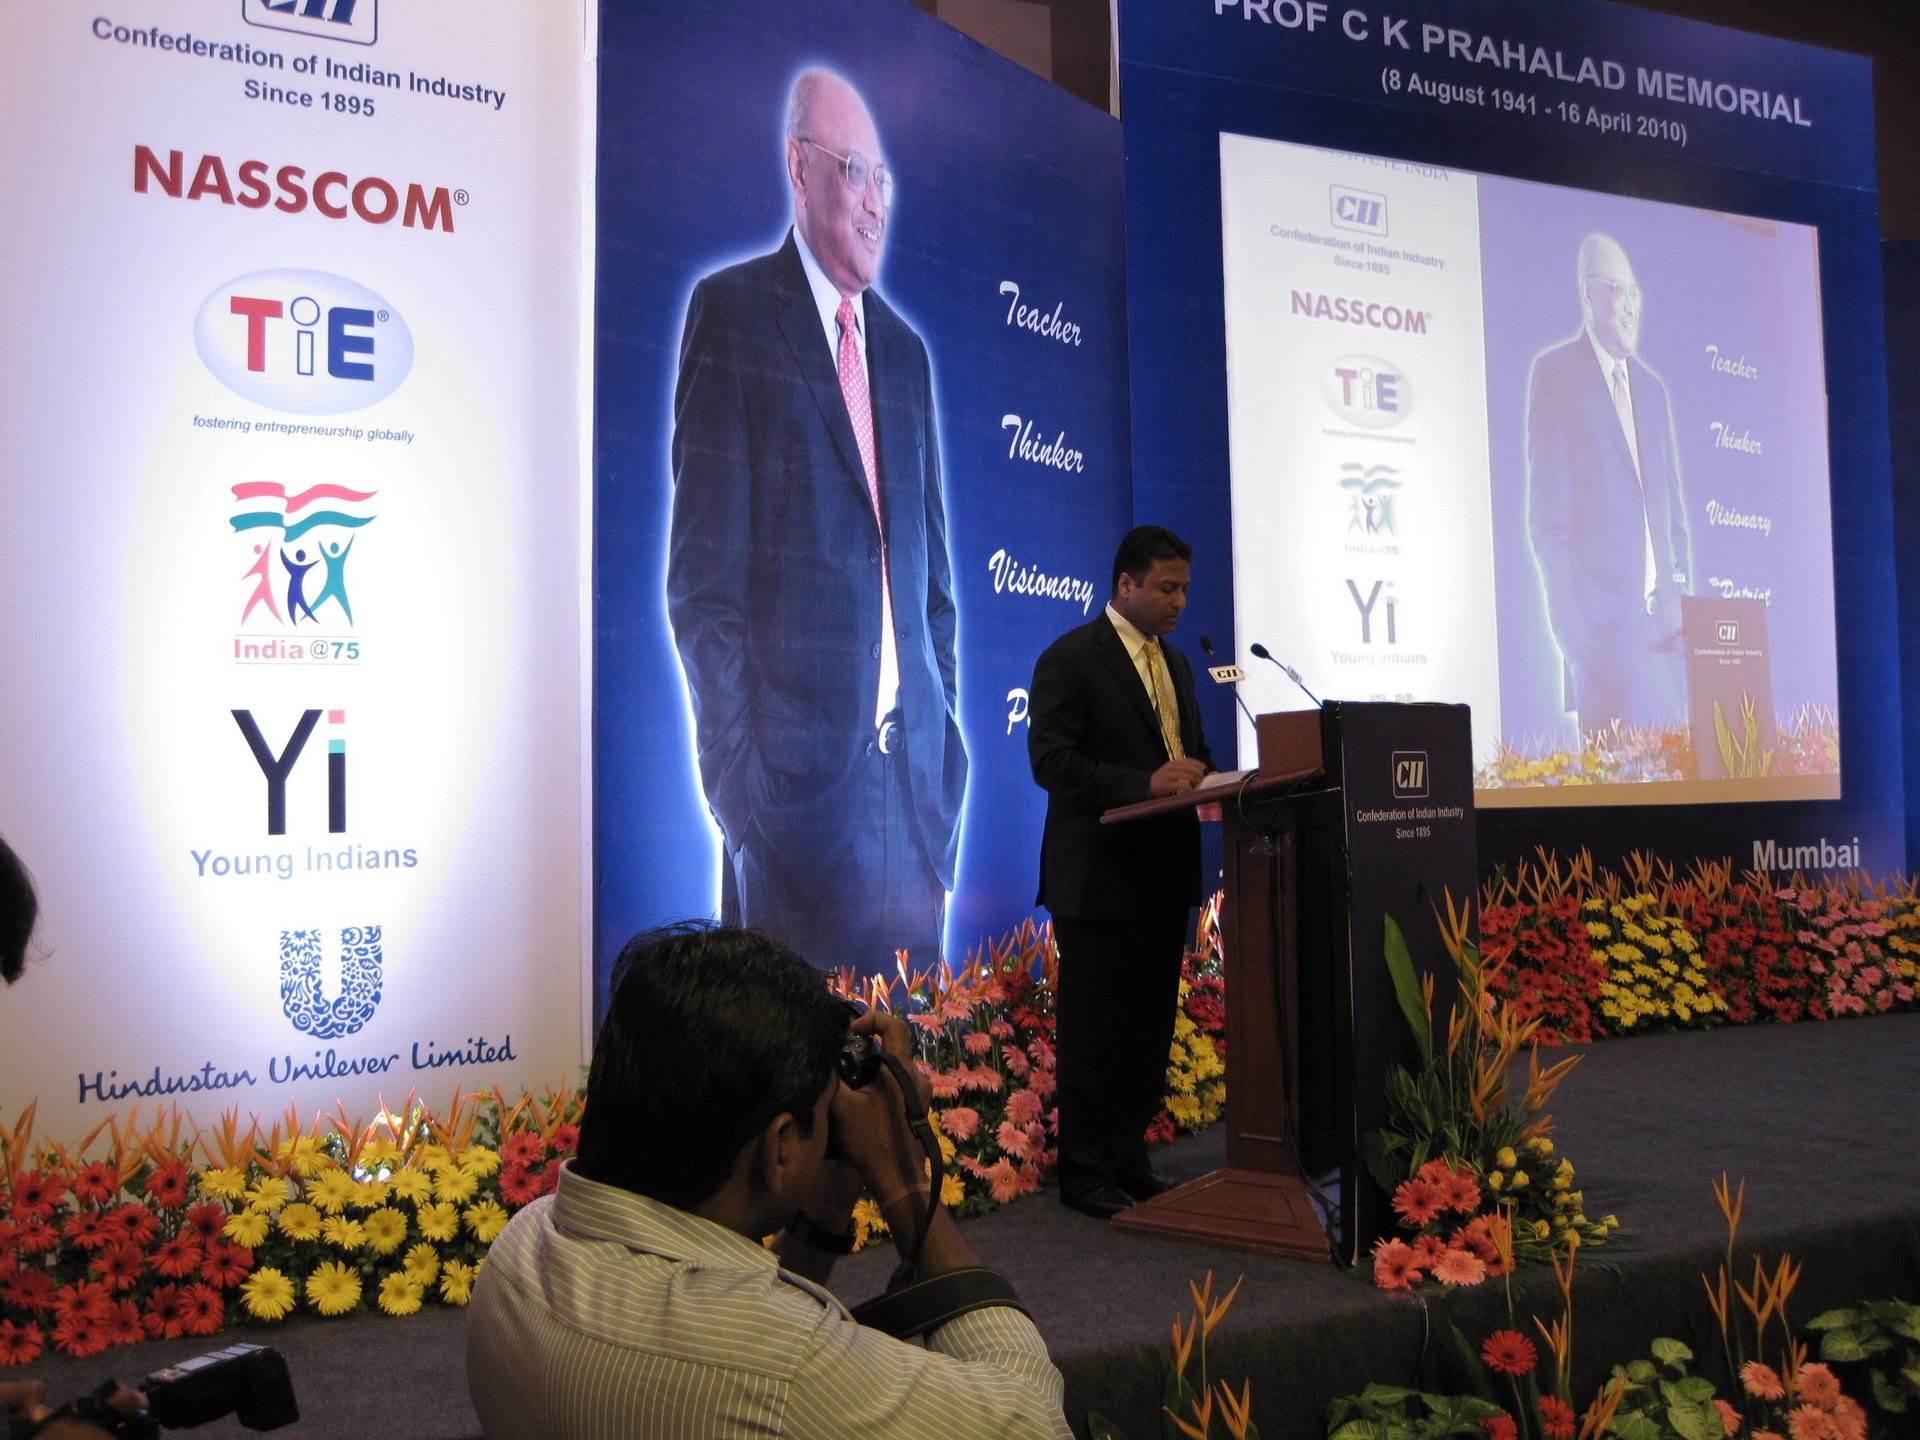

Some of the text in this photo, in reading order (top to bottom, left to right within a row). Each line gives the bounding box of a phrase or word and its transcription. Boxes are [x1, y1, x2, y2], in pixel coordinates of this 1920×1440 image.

[91, 17, 506, 110] Confederation of Indian Industry
[1342, 9, 1370, 41] C
[1382, 15, 1410, 50] K
[1422, 23, 1625, 90] PRAHALAD
[1636, 66, 1812, 127] MEMORIAL
[244, 78, 375, 117] Since 1895
[1381, 67, 1401, 94] (8
[1407, 72, 1485, 105] August
[1491, 88, 1537, 116] 1941
[1557, 101, 1580, 124] 16
[1585, 106, 1631, 133] April
[1637, 115, 1688, 147] 2010)
[1336, 194, 1381, 227] CII
[1270, 224, 1445, 271] Confederation of Indian Industry
[1334, 254, 1390, 275] Since 1895
[999, 280, 1082, 347] Teacher
[1705, 344, 1758, 380] Teacher
[193, 414, 415, 444] fostering entrepreneurship globally
[1001, 414, 1084, 473] Thinker
[1710, 421, 1762, 454] Thinker
[1706, 499, 1771, 537] Visionary
[988, 549, 1094, 616] Visionary
[1345, 579, 1396, 643] Yi
[234, 639, 360, 660] India @75
[1718, 625, 1736, 641] CII
[1217, 668, 1238, 679] CII
[1331, 650, 1376, 668] Young
[230, 709, 346, 835] Yi
[1396, 761, 1424, 789] CII
[1357, 805, 1464, 822] Confederation of Indian Industry
[1396, 825, 1431, 839] Since 1895
[190, 844, 418, 880] Young Indians
[1752, 837, 1860, 871] Mumbai
[78, 1034, 517, 1103] Hindustan Unilever Limited
